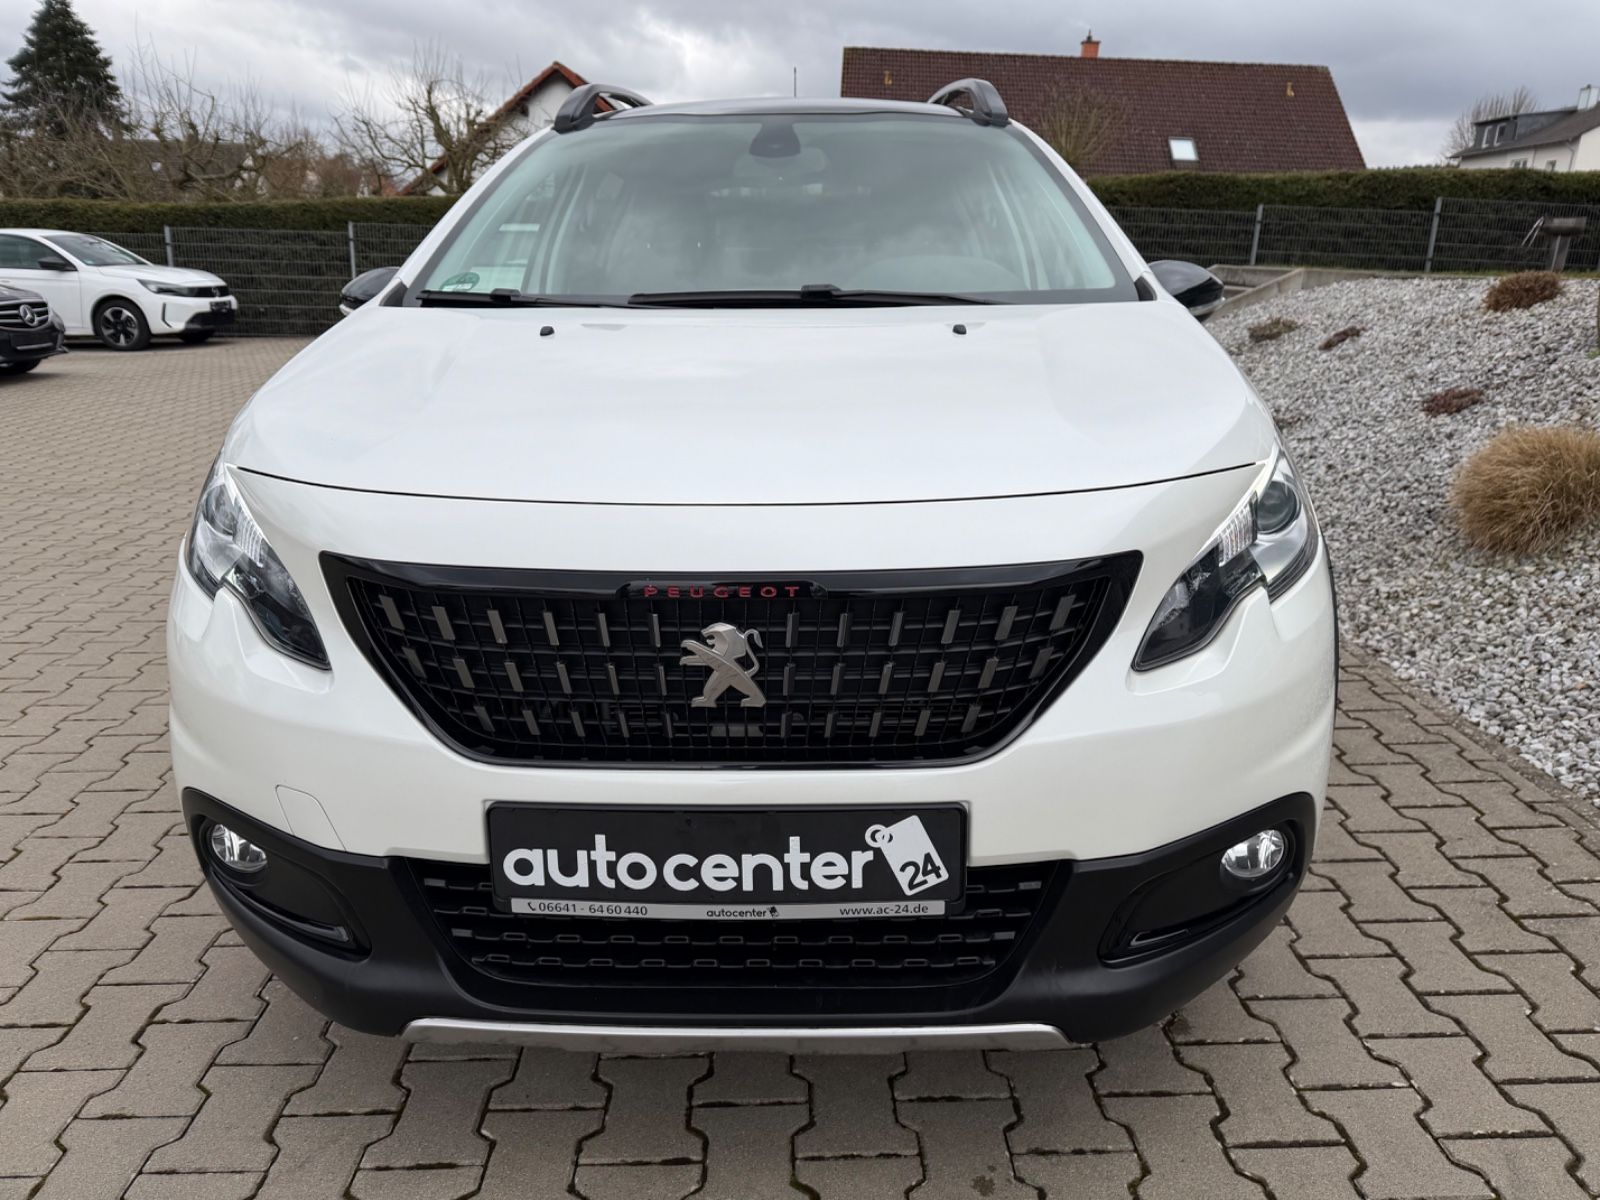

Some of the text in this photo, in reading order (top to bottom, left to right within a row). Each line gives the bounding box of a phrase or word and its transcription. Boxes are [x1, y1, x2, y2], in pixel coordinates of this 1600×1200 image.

[643, 585, 800, 598] PEUGEOT
[899, 852, 942, 891] 24
[706, 908, 767, 918] autocenter
[839, 903, 929, 916] www.ac-24.de
